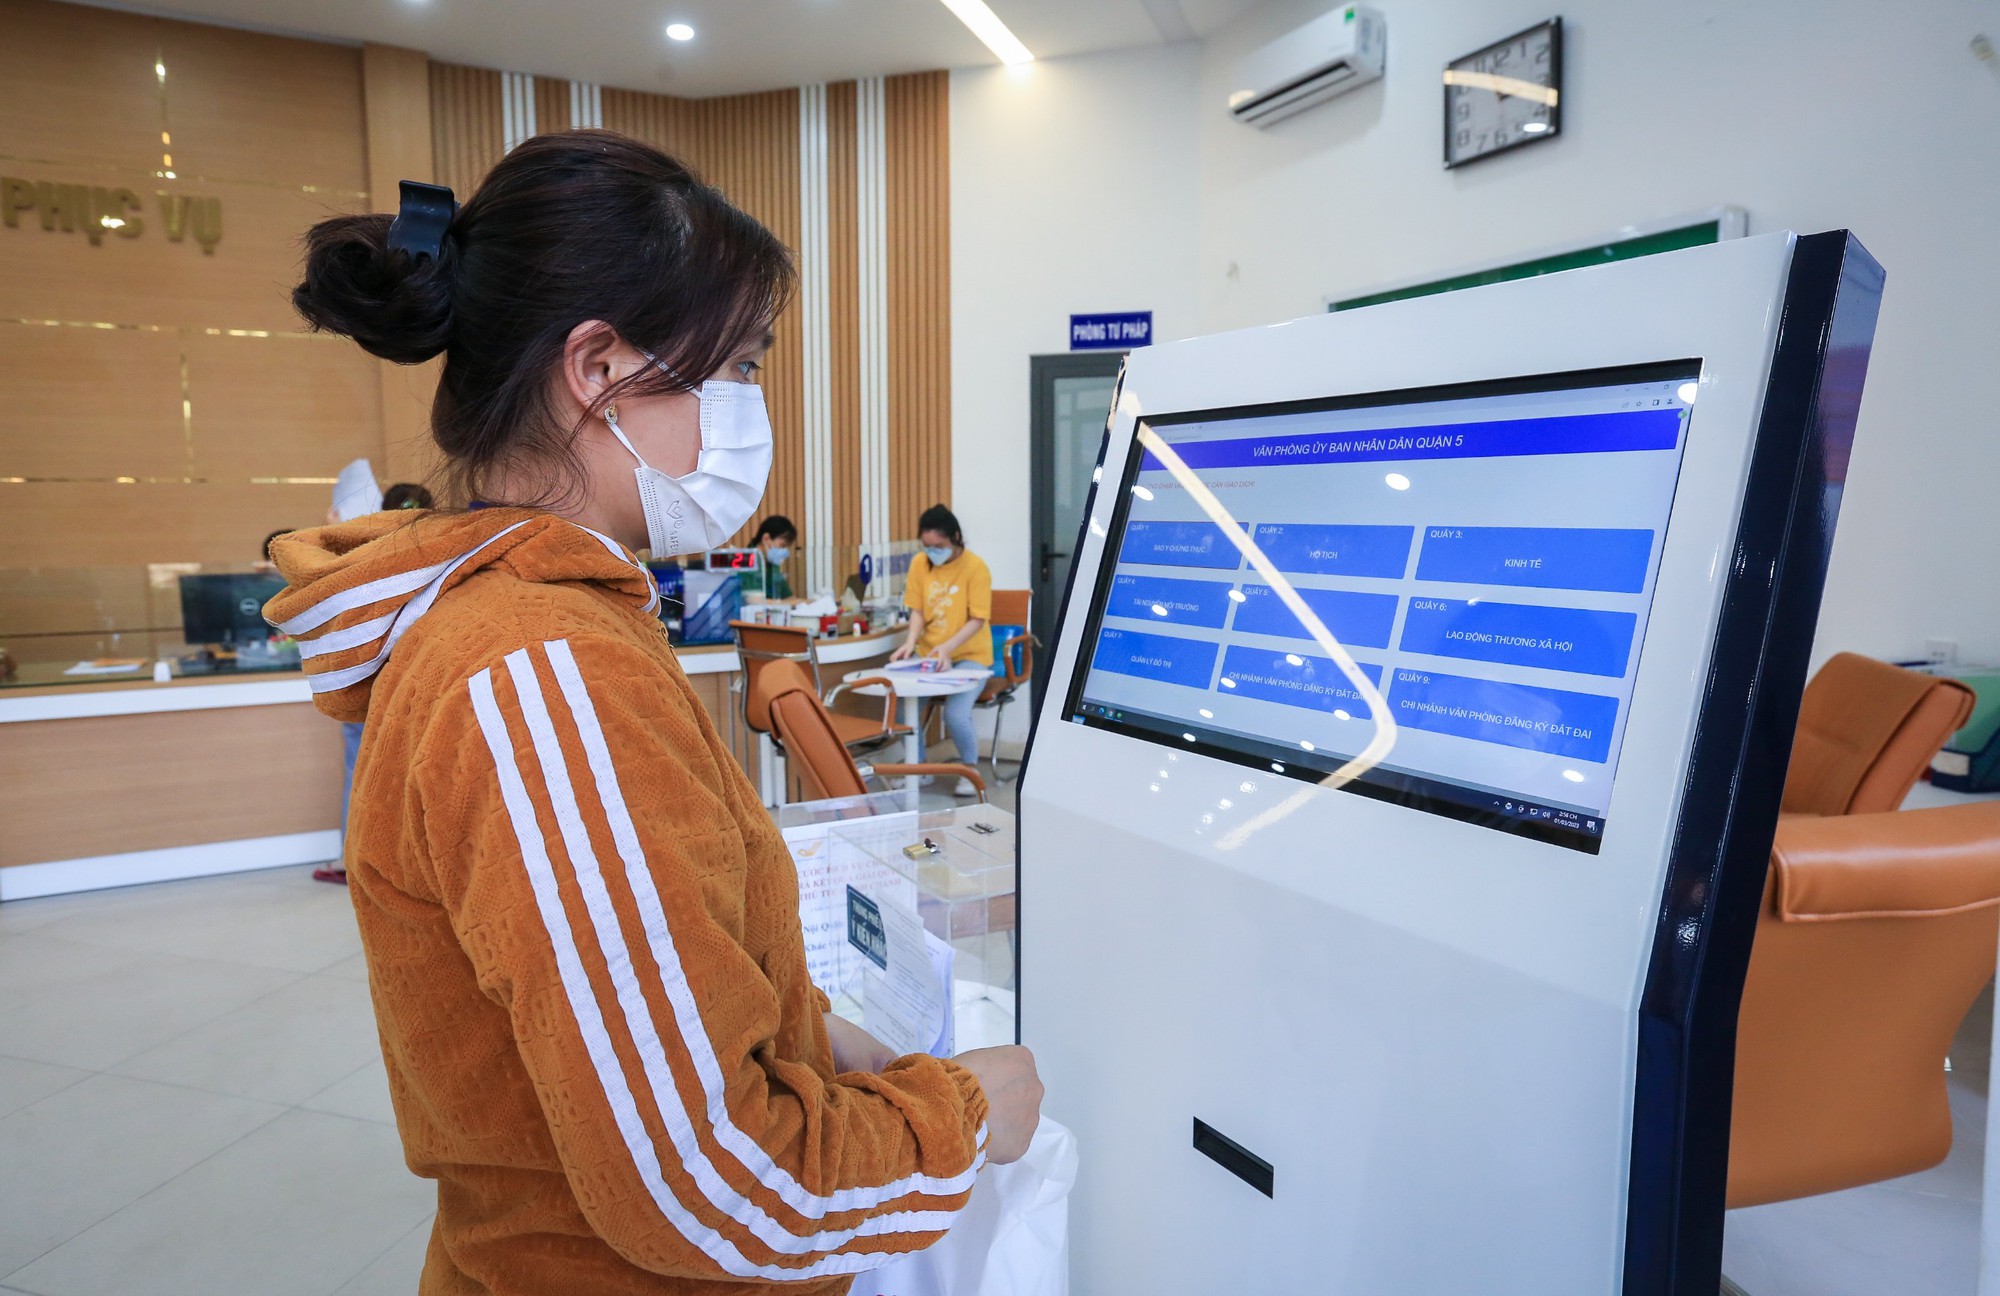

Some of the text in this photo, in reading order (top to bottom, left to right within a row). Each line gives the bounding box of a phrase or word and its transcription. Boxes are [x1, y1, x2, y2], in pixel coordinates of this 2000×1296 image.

[0, 177, 222, 256] PHỤC VỤ
[1073, 318, 1149, 341] PHÒNG TƯ PHÁP
[1253, 434, 1464, 457] VĂN PHÒNG ỦY BAN NHÂN DÂN QUẬN 5
[1455, 530, 1463, 539] 3:
[731, 553, 755, 568] 21
[1322, 551, 1338, 560] TỊCH
[1504, 558, 1542, 569] KINH TẾ
[1439, 602, 1447, 611] 6:
[1446, 630, 1573, 653] LAO ĐỘNG THƯƠNG XÃ HỘI
[1229, 671, 1240, 680] CHI
[1240, 673, 1263, 684] NHÁNH
[1264, 676, 1277, 686] VĂN
[1278, 679, 1303, 690] PHÒNG
[1324, 686, 1336, 696] KÝ
[1336, 688, 1351, 699] ĐẤT
[1423, 676, 1431, 685] 9:
[1401, 699, 1592, 739] CHI NHÁNH VĂN PHÒNG ĐĂNG KÝ ĐẤT ĐAI
[1553, 817, 1580, 829] 01/03/2023
